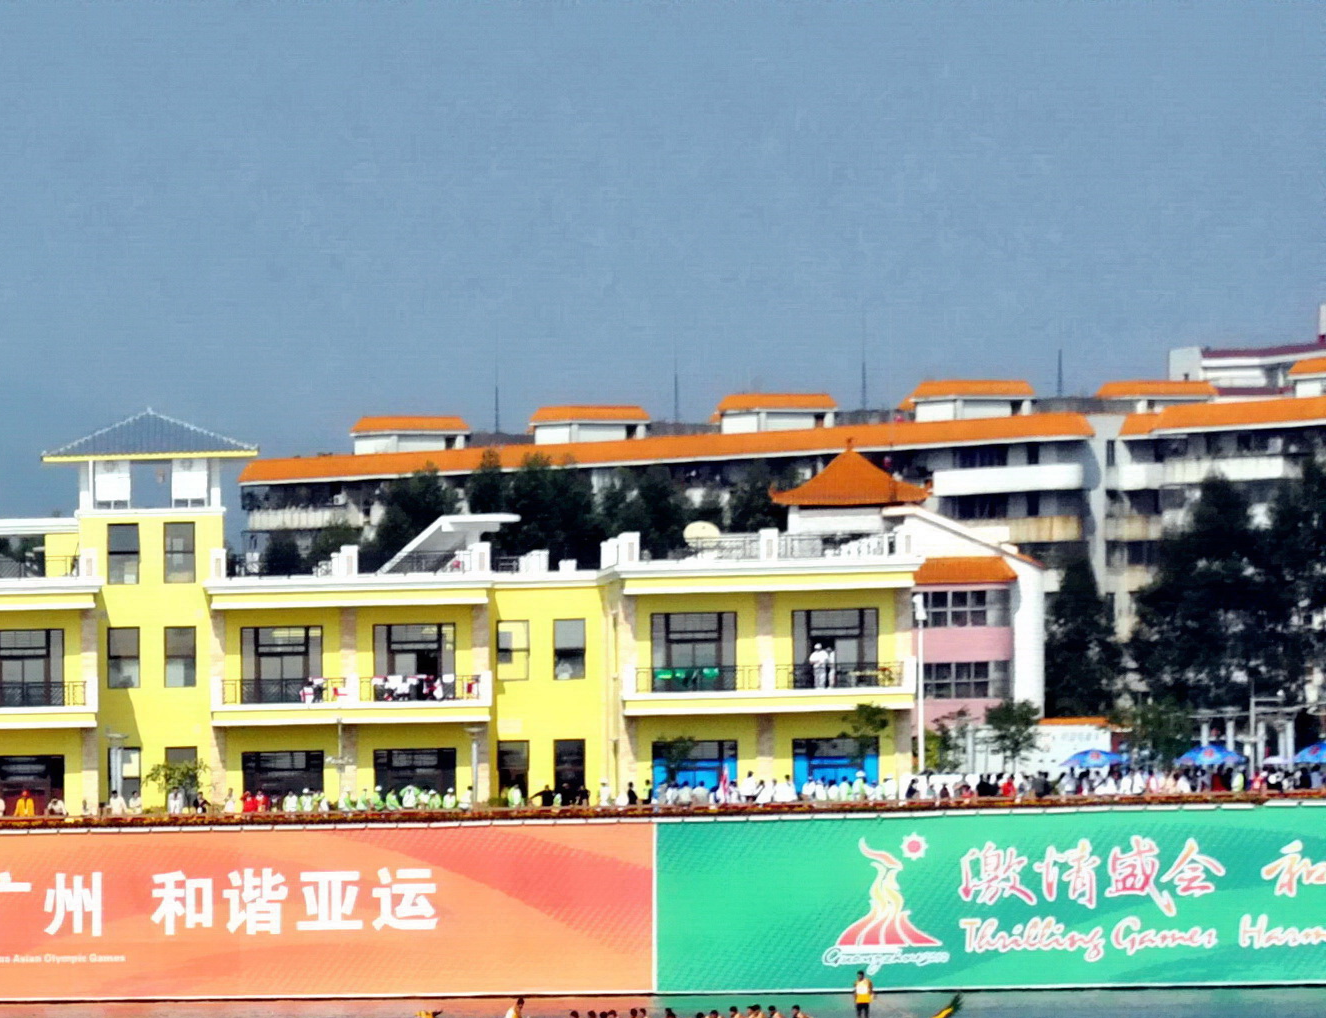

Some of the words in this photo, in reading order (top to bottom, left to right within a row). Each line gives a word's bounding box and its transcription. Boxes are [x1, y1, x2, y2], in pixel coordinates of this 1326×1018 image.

[151, 867, 438, 936] 和谐亚运
[958, 835, 1226, 917] 激情盛会
[13, 954, 42, 963] Asian
[89, 953, 127, 963] Games
[959, 916, 1104, 962] Thrilling
[1110, 915, 1218, 956] Games
